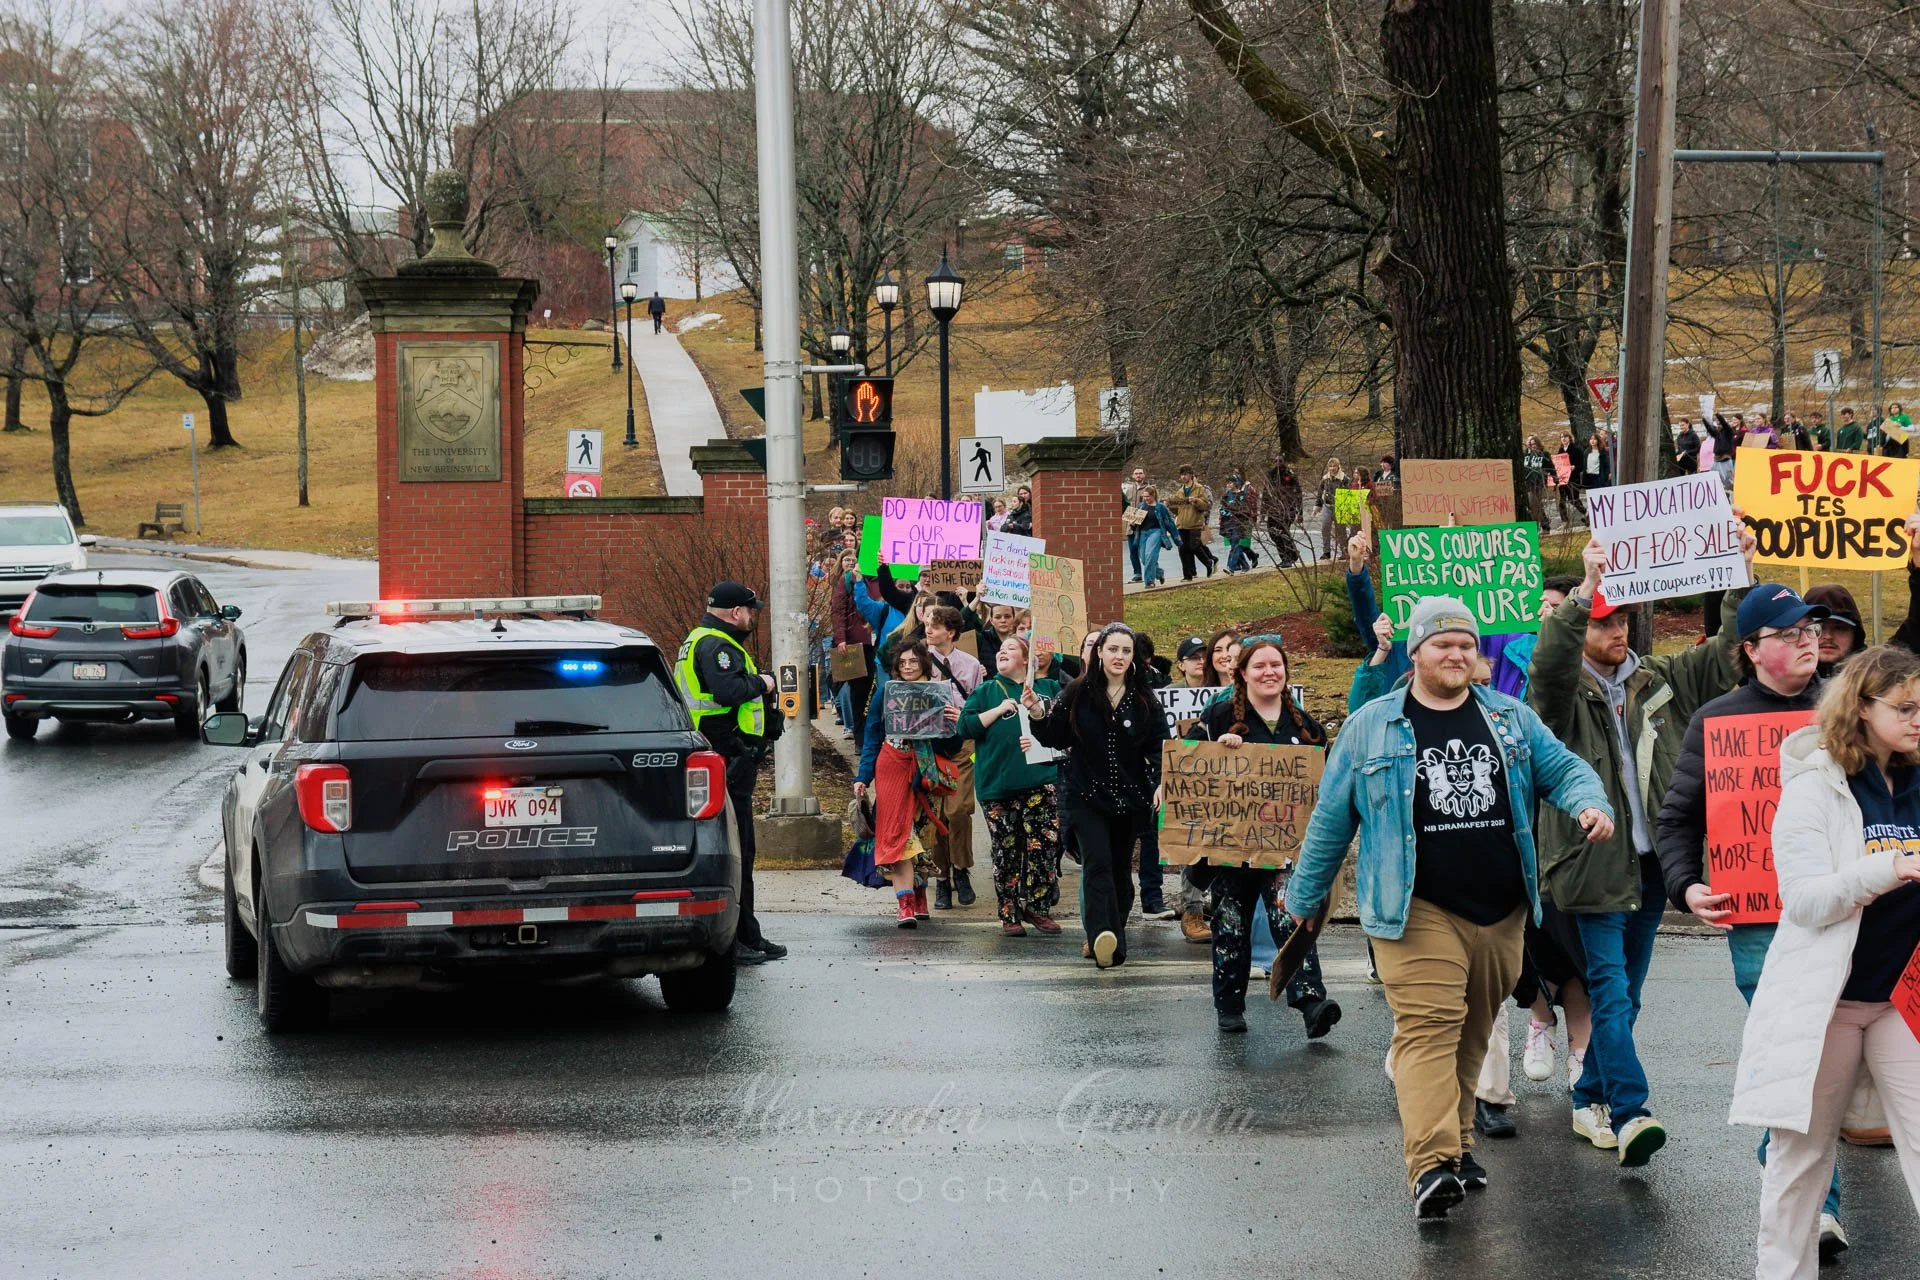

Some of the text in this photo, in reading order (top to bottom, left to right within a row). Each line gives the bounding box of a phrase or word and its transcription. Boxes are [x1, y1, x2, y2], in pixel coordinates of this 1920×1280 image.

[412, 447, 488, 456] THE UNIVERSITY
[434, 465, 490, 473] BRUNSWICK
[1450, 462, 1509, 482] CREATE
[1769, 454, 1893, 497] FUCK
[885, 499, 982, 524] DO NOT CUT
[1403, 494, 1460, 514] STUDENT
[1590, 480, 1717, 528] MY EDUCATION
[1797, 495, 1846, 516] TES
[909, 524, 944, 542] OUR
[892, 541, 974, 564] FUTURE
[1386, 532, 1435, 561] VOS
[931, 560, 982, 570] EDUCATION
[1029, 553, 1054, 571] STU
[932, 574, 939, 584] IS
[942, 574, 957, 585] THE
[1385, 560, 1540, 588] ELLES FONT PAS
[1606, 583, 1625, 599] NON
[1629, 580, 1650, 596] AUX
[1158, 688, 1217, 708] IF YO
[1710, 728, 1752, 757] MAKE
[633, 753, 679, 767] 302
[1166, 750, 1308, 779] I COULD HAVE
[1708, 766, 1782, 793] MORE ACCE
[1164, 778, 1221, 800] MADE
[1226, 780, 1259, 800] THIS
[1260, 782, 1309, 803] BETTER
[489, 799, 557, 817] JVK 094
[1168, 801, 1212, 822] THEY
[1258, 802, 1297, 823] CUT
[1182, 821, 1300, 851] THE ARTS
[1438, 821, 1489, 831] DRAMAFEST
[447, 827, 598, 851] POLICE
[1710, 842, 1757, 872] MORE
[1746, 893, 1769, 912] AUX
